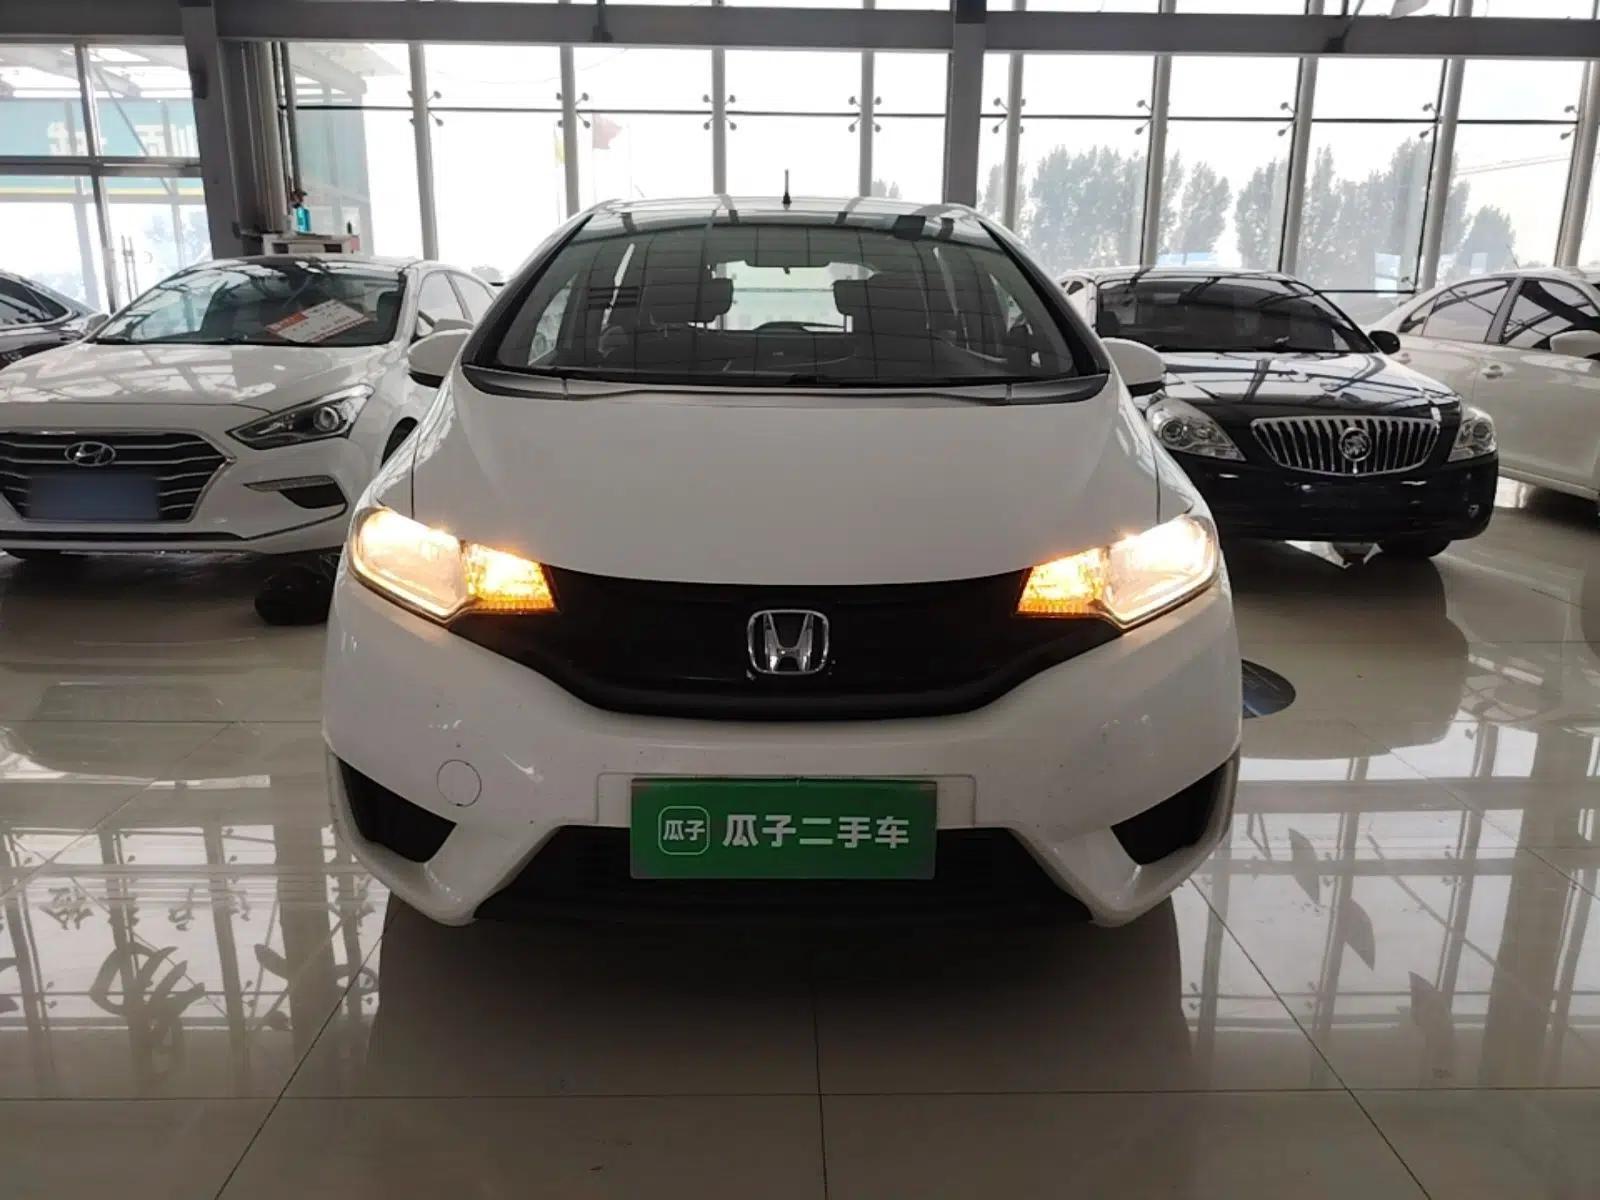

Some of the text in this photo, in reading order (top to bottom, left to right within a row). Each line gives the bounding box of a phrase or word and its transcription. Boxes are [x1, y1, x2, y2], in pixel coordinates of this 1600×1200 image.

[663, 819, 706, 842] 瓜子
[723, 814, 910, 849] 瓜子二手车
